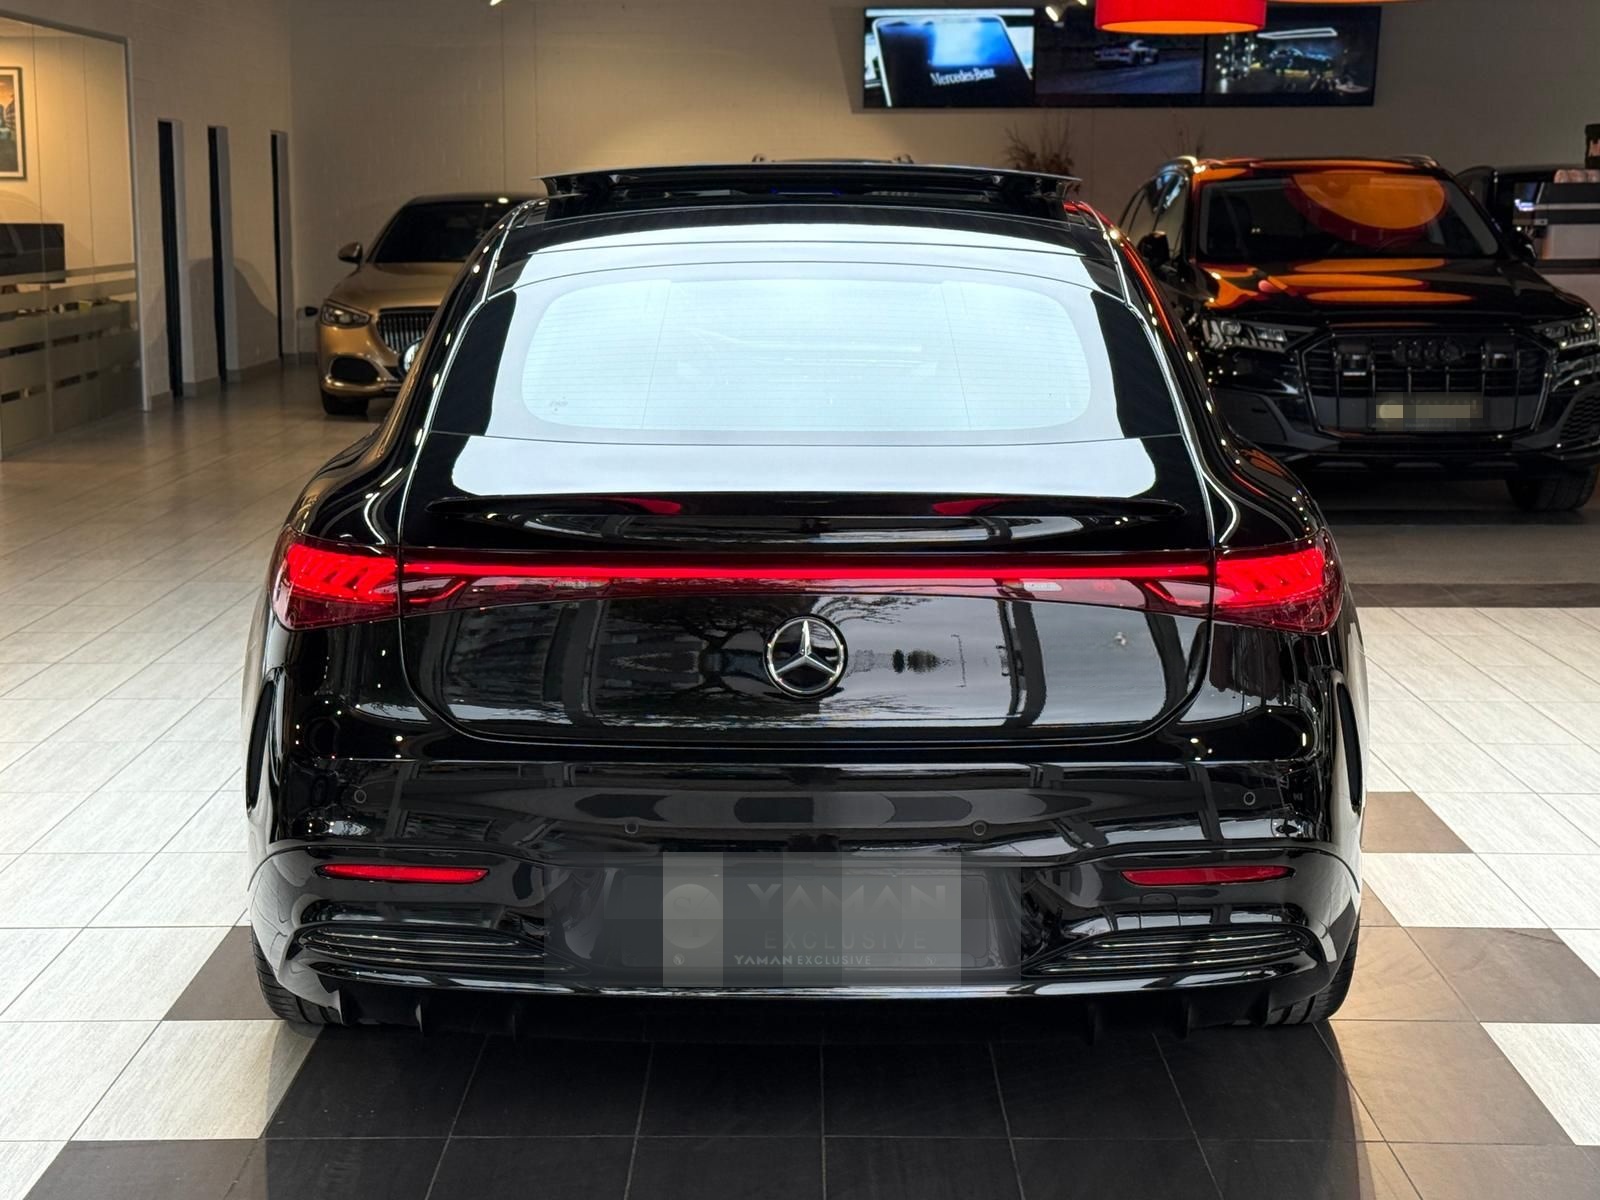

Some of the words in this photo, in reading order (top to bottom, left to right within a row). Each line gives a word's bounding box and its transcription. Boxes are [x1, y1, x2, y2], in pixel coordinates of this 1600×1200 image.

[930, 68, 996, 85] Mercedes-Benz
[747, 883, 945, 913] YAMAN
[764, 930, 926, 950] EXCLUSIVE
[734, 955, 793, 965] YAMAN
[797, 955, 872, 965] EXCLUSIVE
